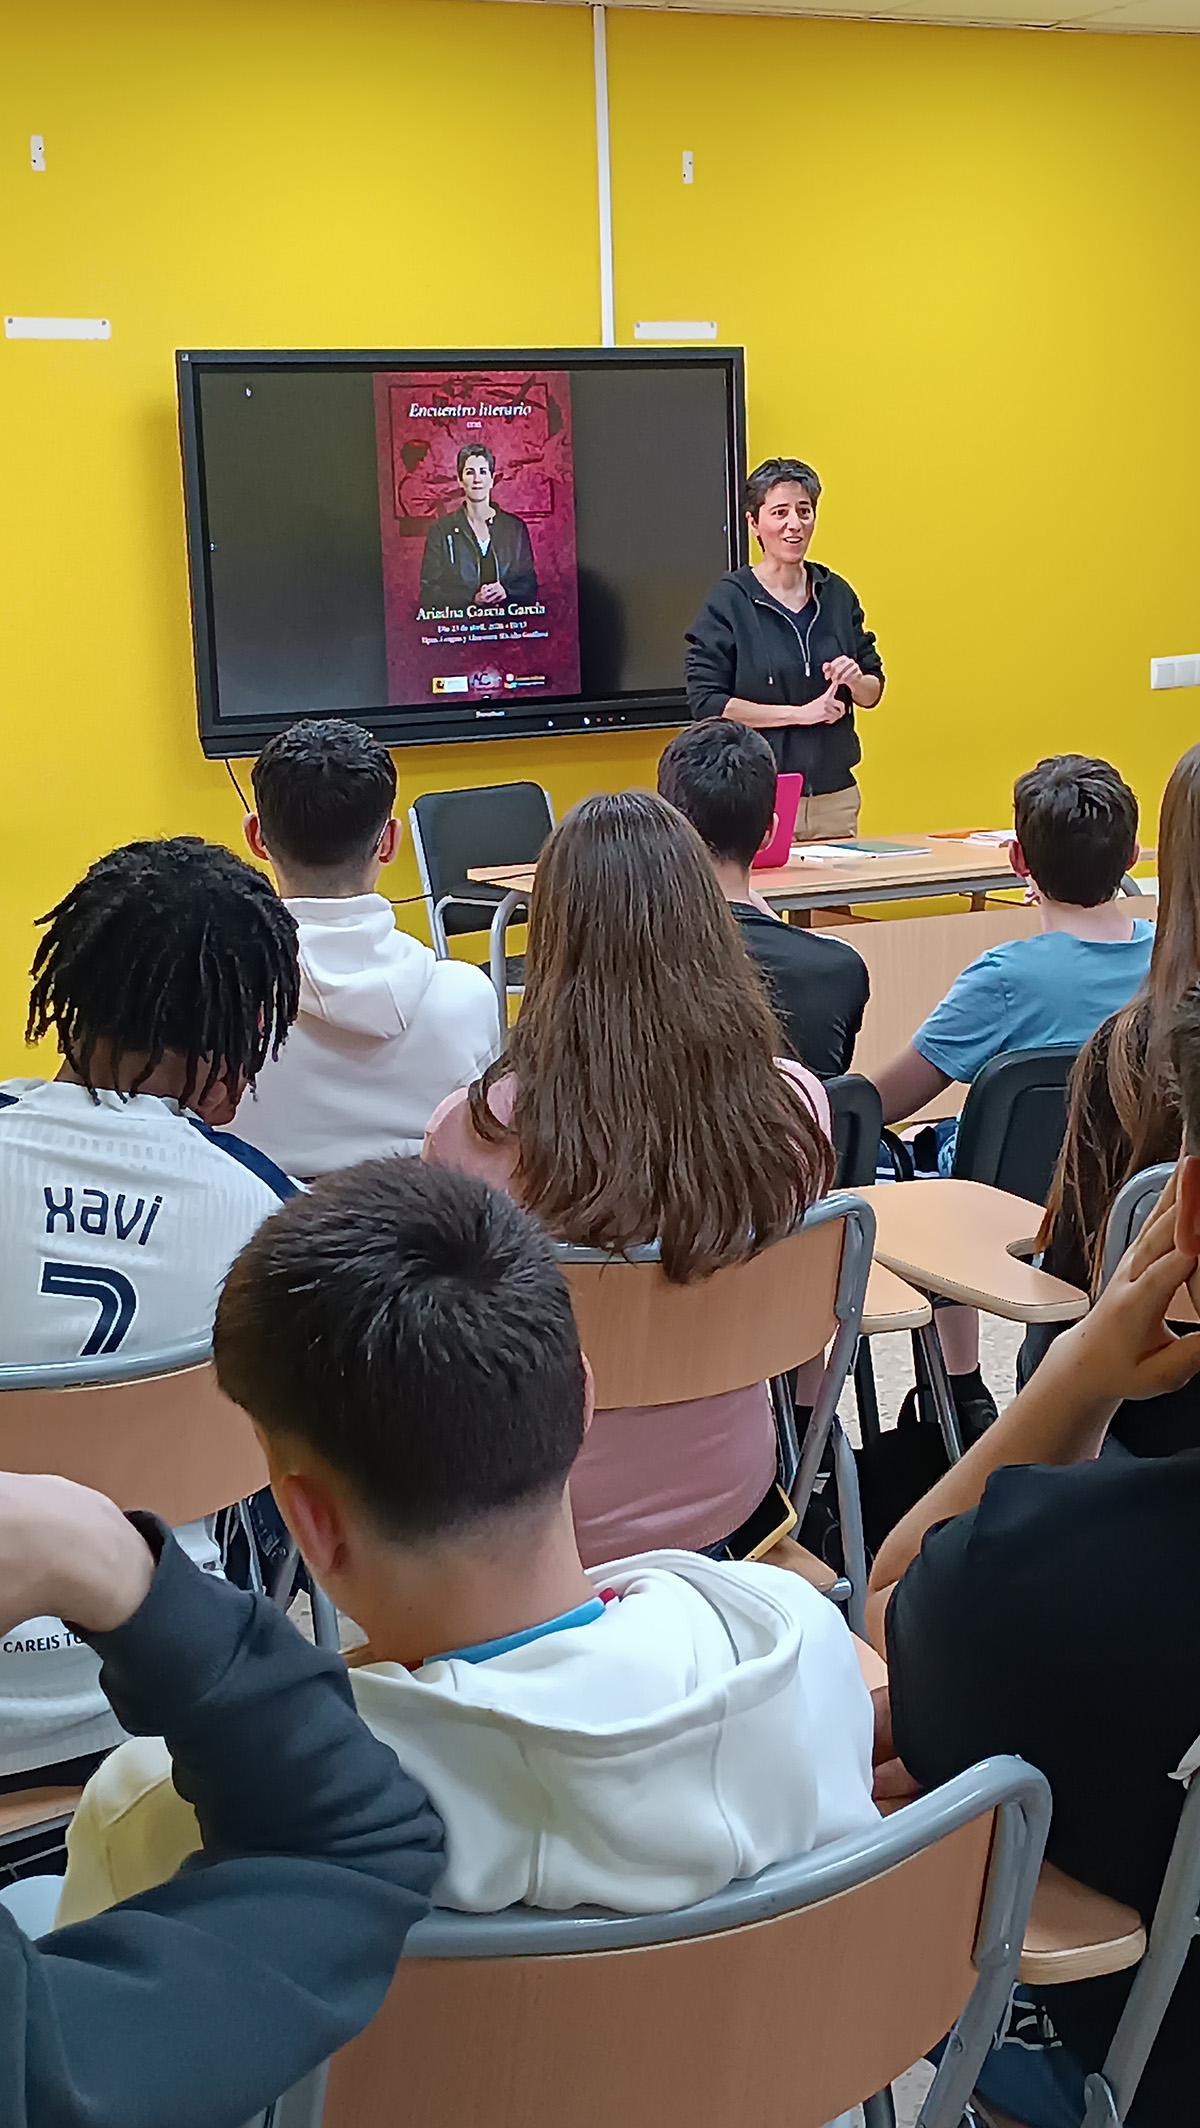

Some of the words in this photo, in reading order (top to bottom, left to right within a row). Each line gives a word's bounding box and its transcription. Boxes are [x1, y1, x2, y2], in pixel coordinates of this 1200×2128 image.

[409, 403, 476, 417] Encuentro
[479, 401, 532, 417] literario
[416, 606, 464, 620] Ariadna
[39, 1259, 138, 1357] 7
